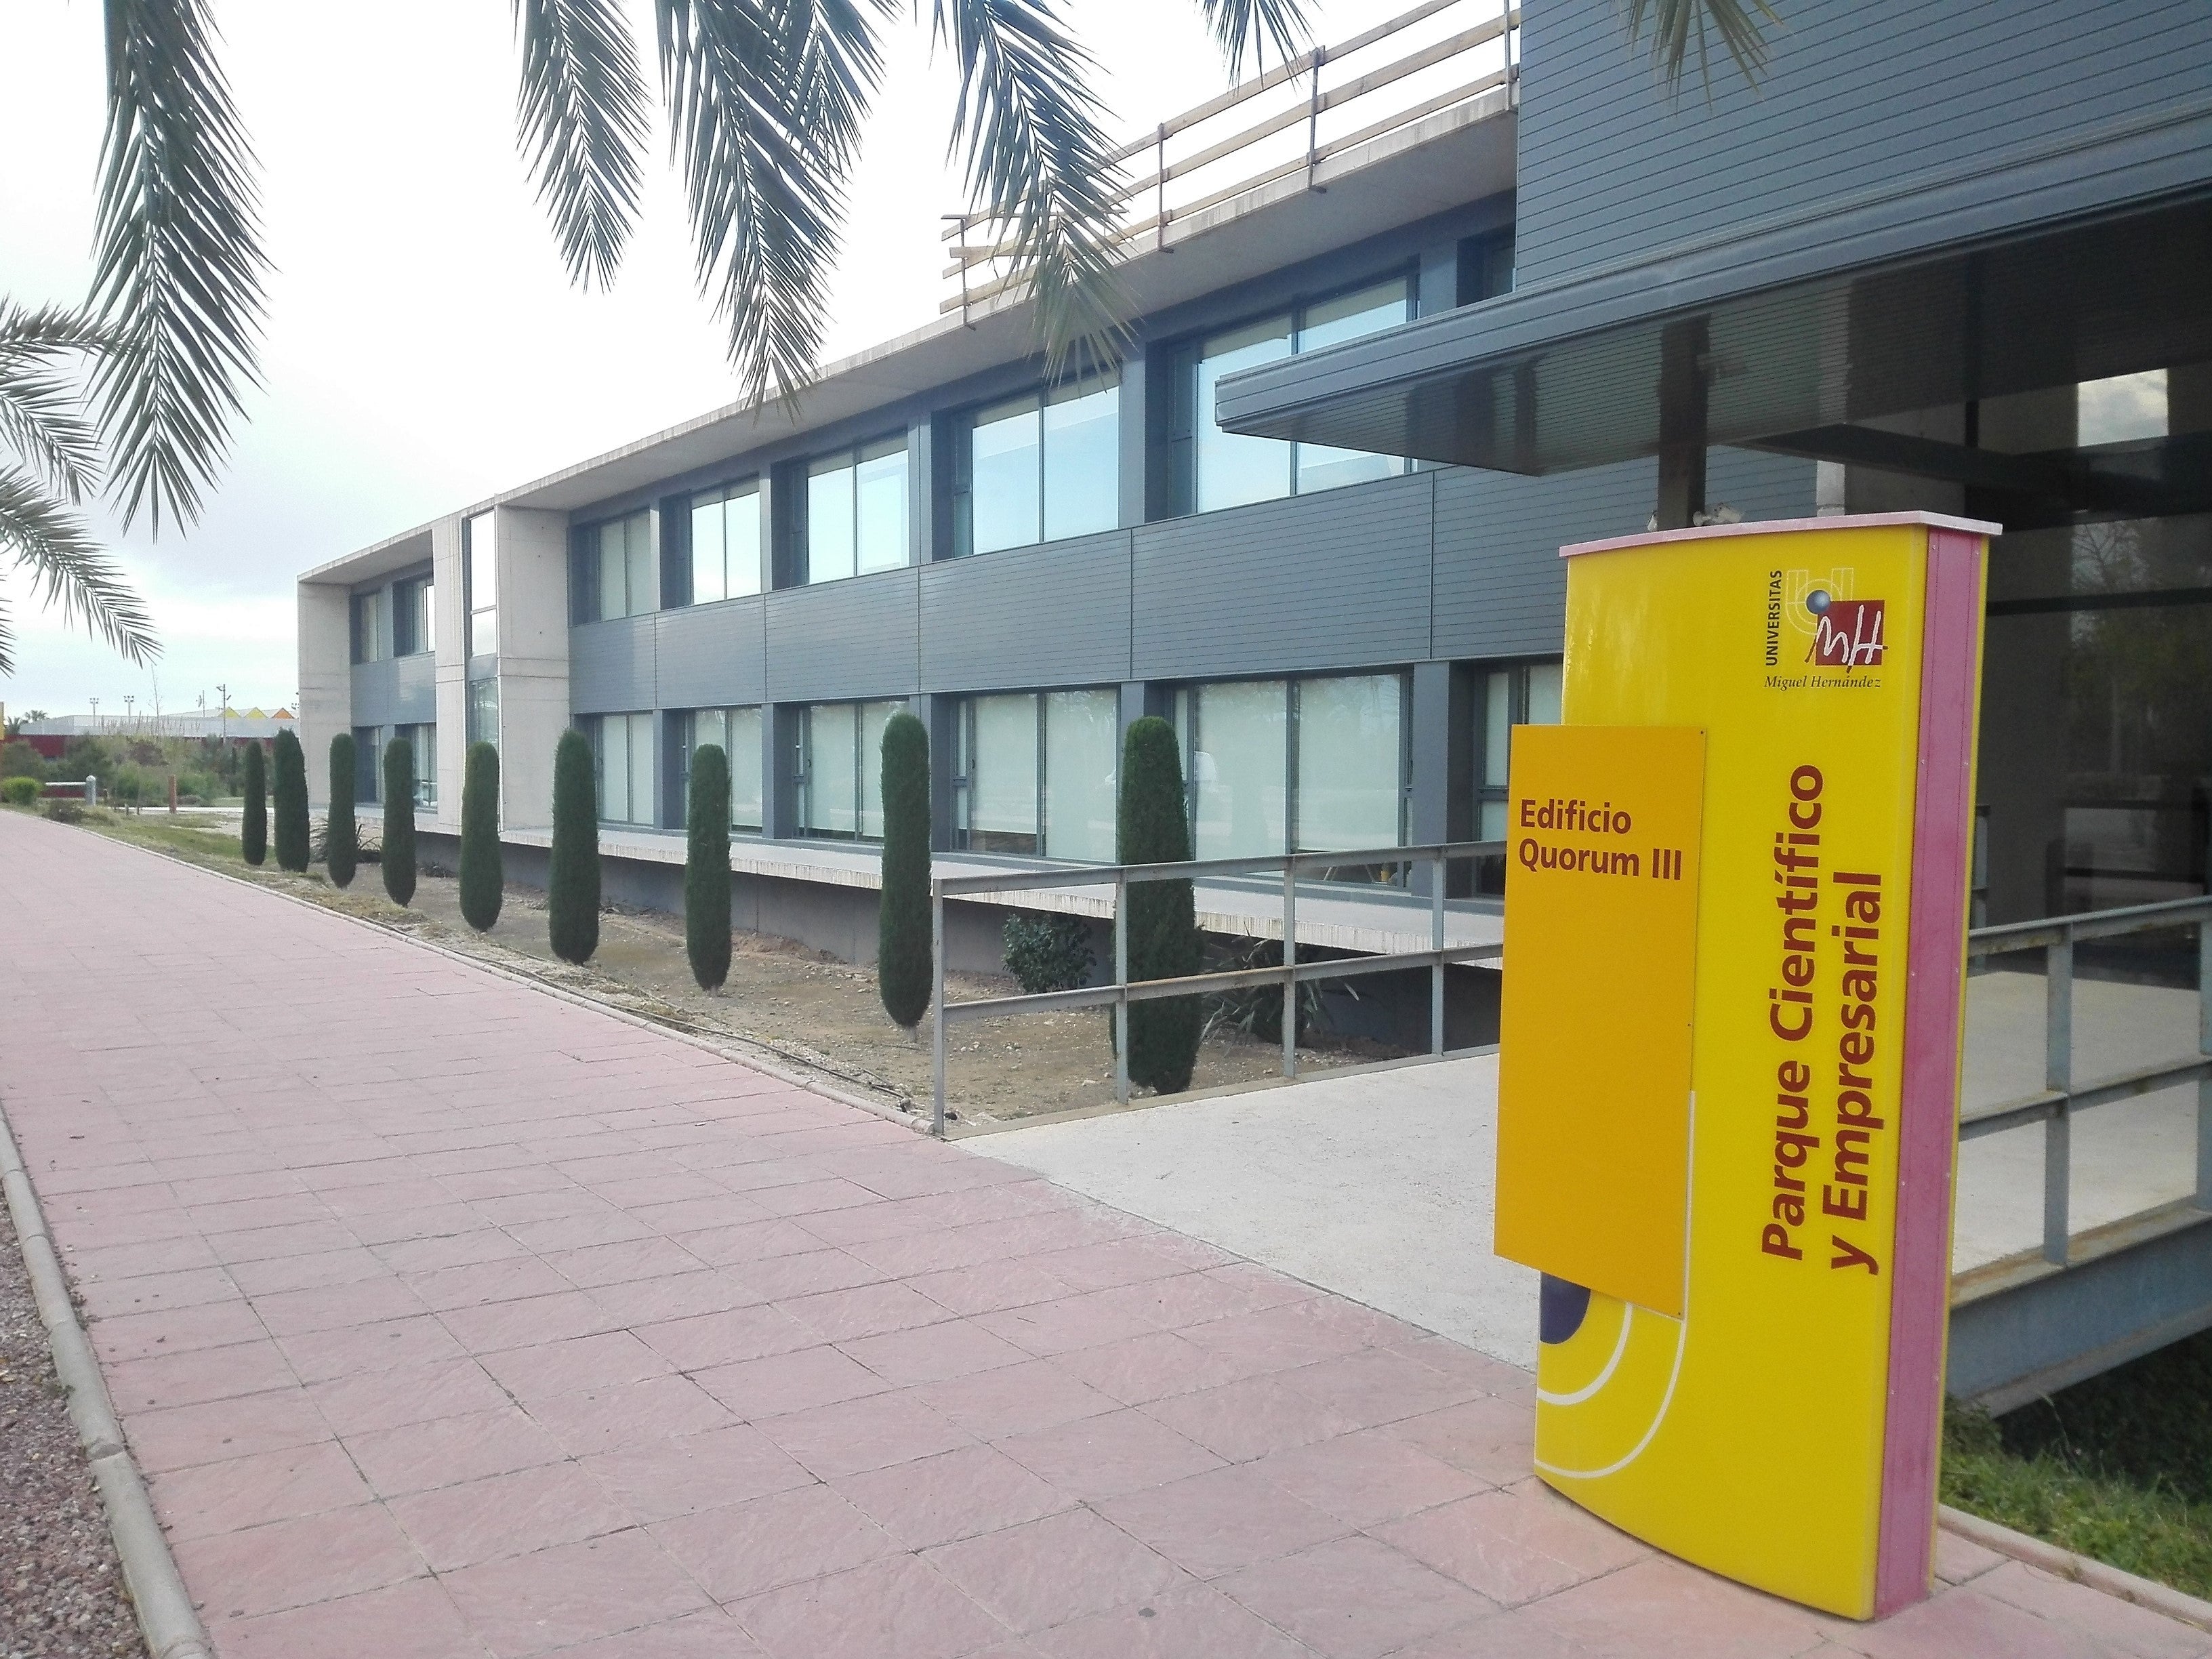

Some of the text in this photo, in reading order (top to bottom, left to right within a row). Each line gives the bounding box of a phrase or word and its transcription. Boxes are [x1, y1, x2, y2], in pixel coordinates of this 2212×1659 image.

[1765, 569, 1782, 666] UNIVERSITAS
[1763, 675, 1881, 691] Miguel Hernández
[1520, 798, 1632, 834] Edificio
[1519, 838, 1682, 881] Quorum III
[1762, 764, 1824, 1261] Parque Científico
[1822, 872, 1885, 1275] y Empresarial
